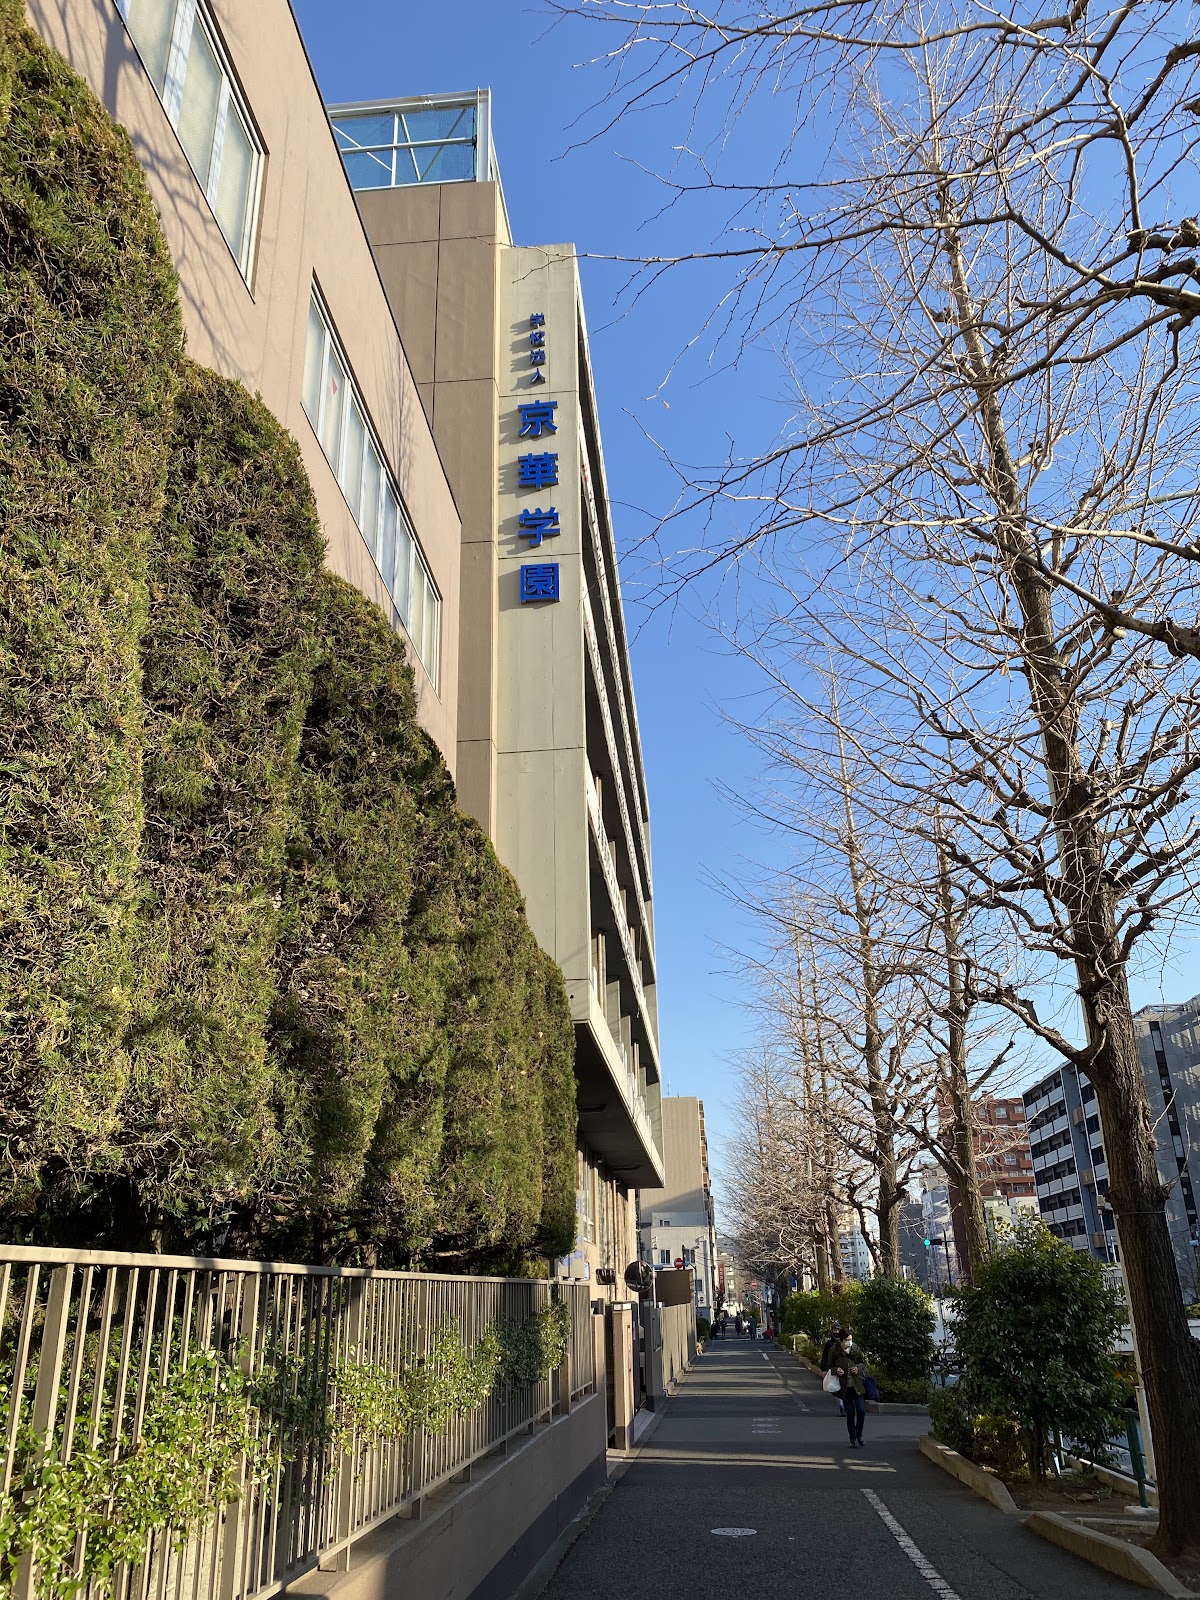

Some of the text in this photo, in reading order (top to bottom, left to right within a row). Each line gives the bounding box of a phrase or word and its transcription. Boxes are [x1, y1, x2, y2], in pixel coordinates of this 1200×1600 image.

[529, 312, 546, 385] 学校法人
[518, 400, 560, 602] 京華学園
